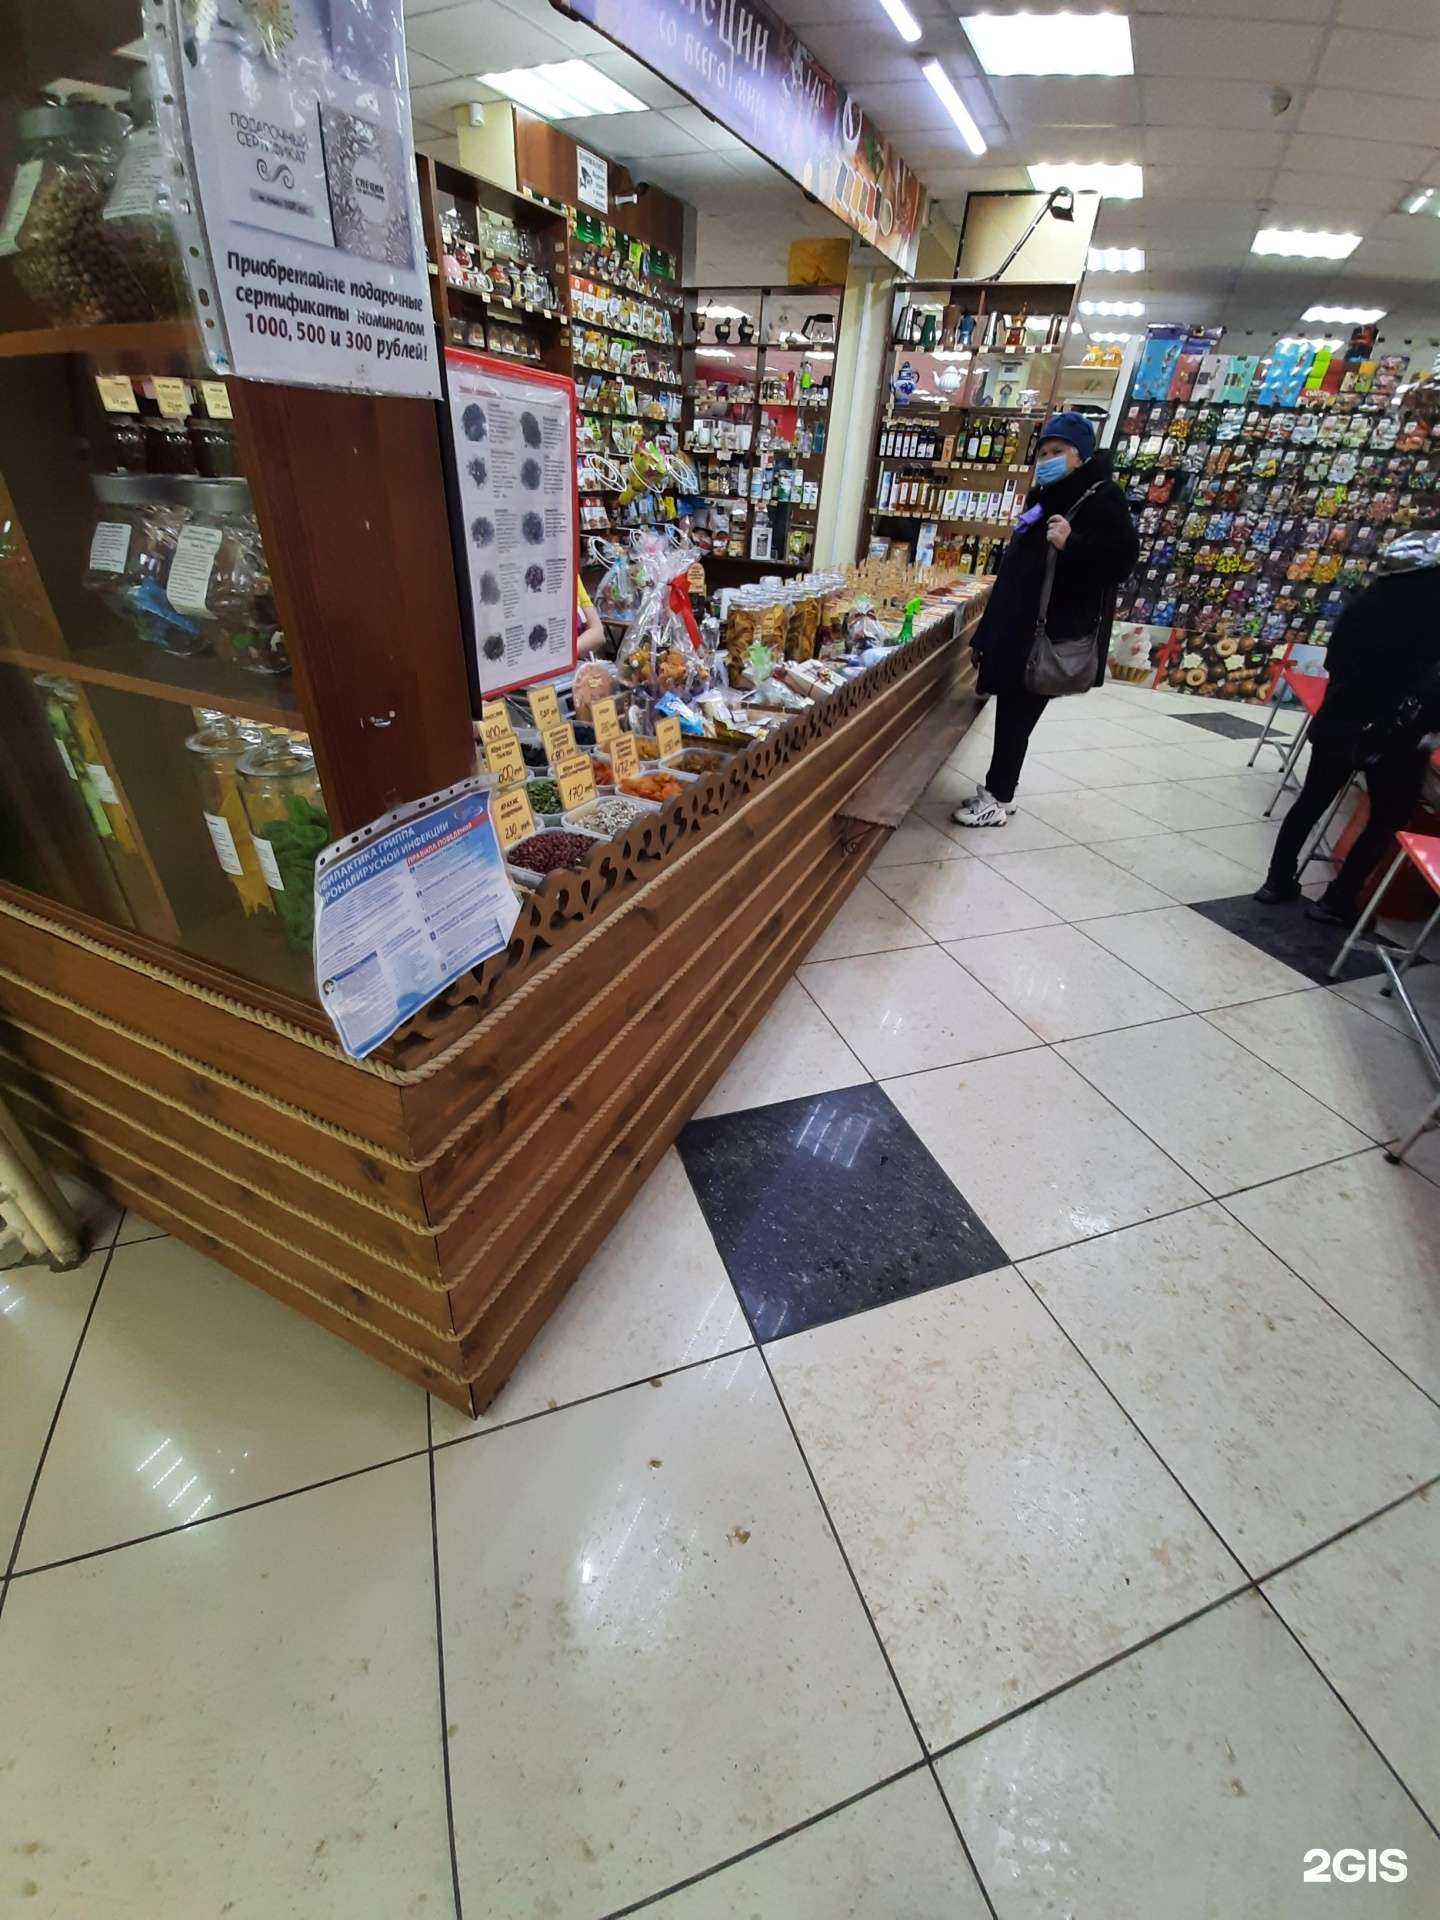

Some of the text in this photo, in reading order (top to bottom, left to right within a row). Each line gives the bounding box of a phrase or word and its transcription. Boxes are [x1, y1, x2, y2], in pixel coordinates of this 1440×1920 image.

[227, 251, 423, 312] Приобретайте подарочные
[235, 285, 425, 337] сертификаты номиналом
[245, 312, 428, 362] 1000, 500 и 300 рублей!
[378, 826, 415, 858] ГРИППА
[400, 820, 449, 854] ИНФЕКЦИИ
